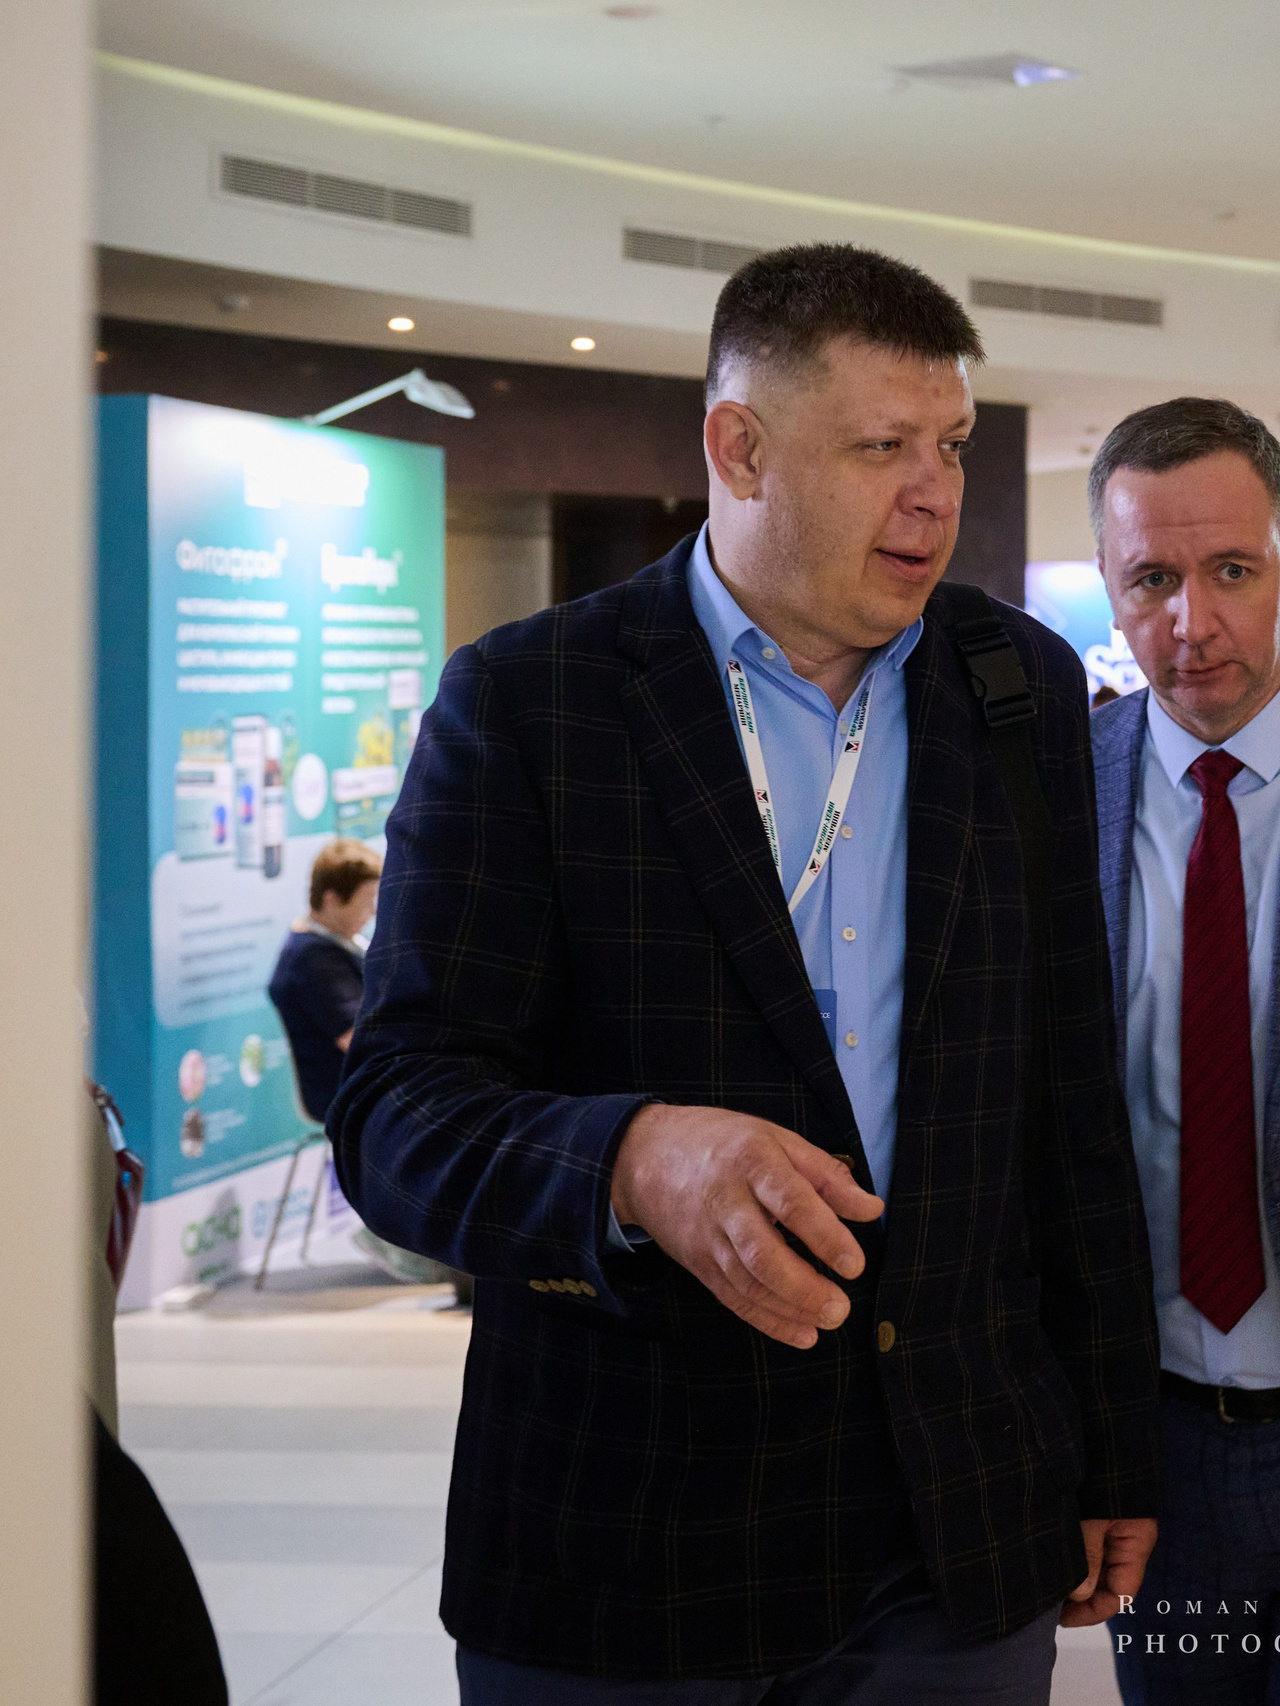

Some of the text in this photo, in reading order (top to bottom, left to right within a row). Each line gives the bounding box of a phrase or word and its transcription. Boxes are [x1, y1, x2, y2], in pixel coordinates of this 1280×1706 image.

[734, 683, 747, 726] МЕНАРИНИ
[738, 677, 755, 734] БЕРЛИН-ХЕМИ
[765, 808, 780, 867] БЕРЛИН-ХЕМИ
[816, 800, 836, 855] БЕРЛИН-ХЕМИ
[823, 810, 841, 852] МЕНАРИНИ
